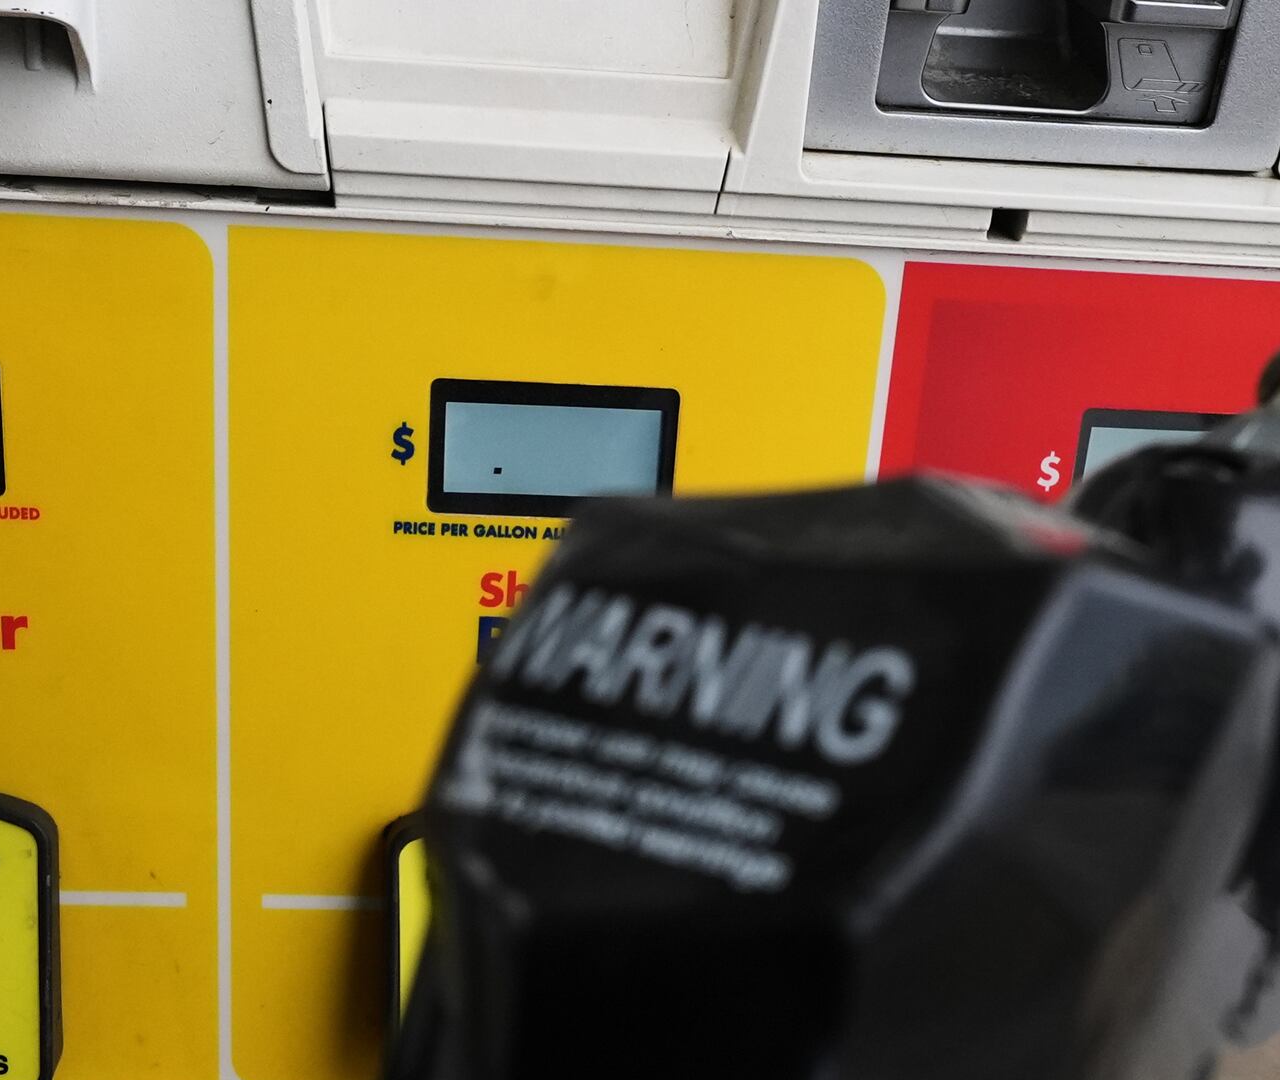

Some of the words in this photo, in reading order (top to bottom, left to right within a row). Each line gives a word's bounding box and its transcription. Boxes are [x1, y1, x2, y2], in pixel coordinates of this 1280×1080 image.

[391, 421, 415, 466] $
[1036, 451, 1061, 492] $
[393, 521, 436, 536] PRICE
[440, 522, 468, 538] PER
[473, 524, 538, 540] GALLON
[491, 583, 916, 766] WARNING
